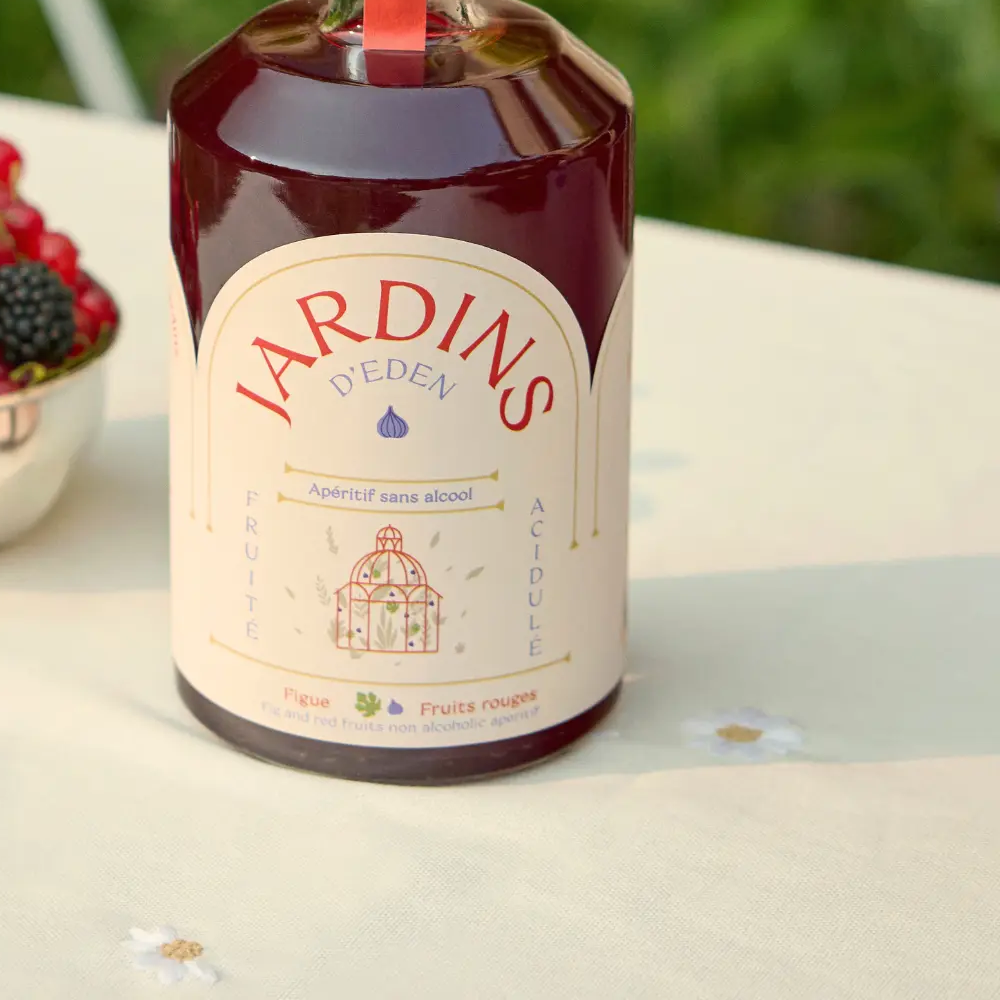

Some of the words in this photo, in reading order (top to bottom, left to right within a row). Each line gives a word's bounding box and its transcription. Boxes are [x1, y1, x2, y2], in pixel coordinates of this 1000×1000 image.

[236, 279, 554, 432] JARDINS
[329, 358, 457, 400] D'EDEN
[308, 482, 376, 502] Apéritif
[380, 492, 418, 503] sans
[424, 486, 473, 503] alcool
[245, 490, 259, 640] FRUITÉ
[529, 498, 545, 657] ACIDULÉ
[284, 687, 330, 708] Figue
[420, 701, 475, 716] Fruits
[482, 690, 537, 710] rouges
[285, 709, 309, 723] and
[314, 715, 337, 728] red
[342, 717, 384, 732] fruits
[388, 722, 417, 733] non
[423, 716, 486, 733] alcoholic
